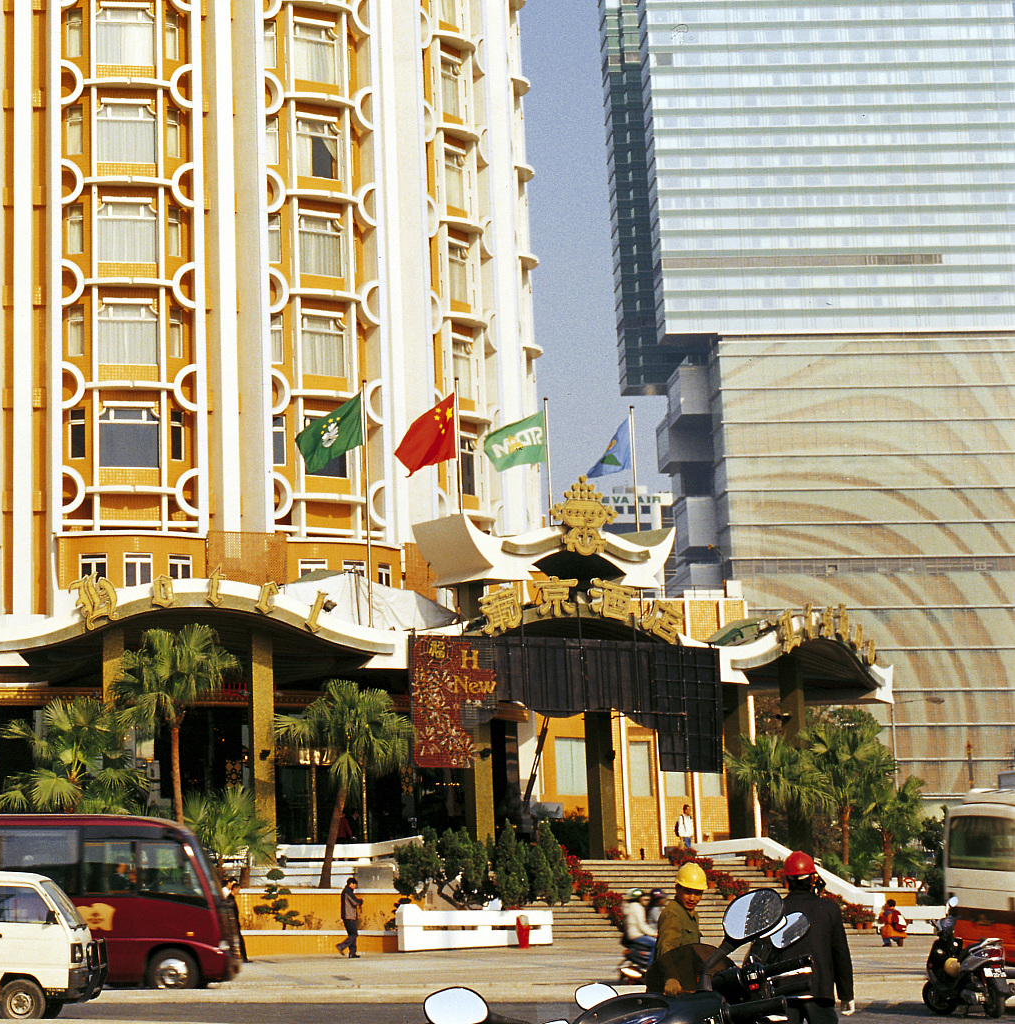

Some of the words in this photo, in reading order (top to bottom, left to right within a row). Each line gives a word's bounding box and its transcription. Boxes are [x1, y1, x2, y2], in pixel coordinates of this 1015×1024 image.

[601, 496, 630, 504] EVA
[636, 496, 662, 504] AIR
[68, 563, 330, 634] Hotel
[478, 575, 686, 645] 葡京酒店
[460, 649, 480, 670] H
[453, 675, 498, 694] New
